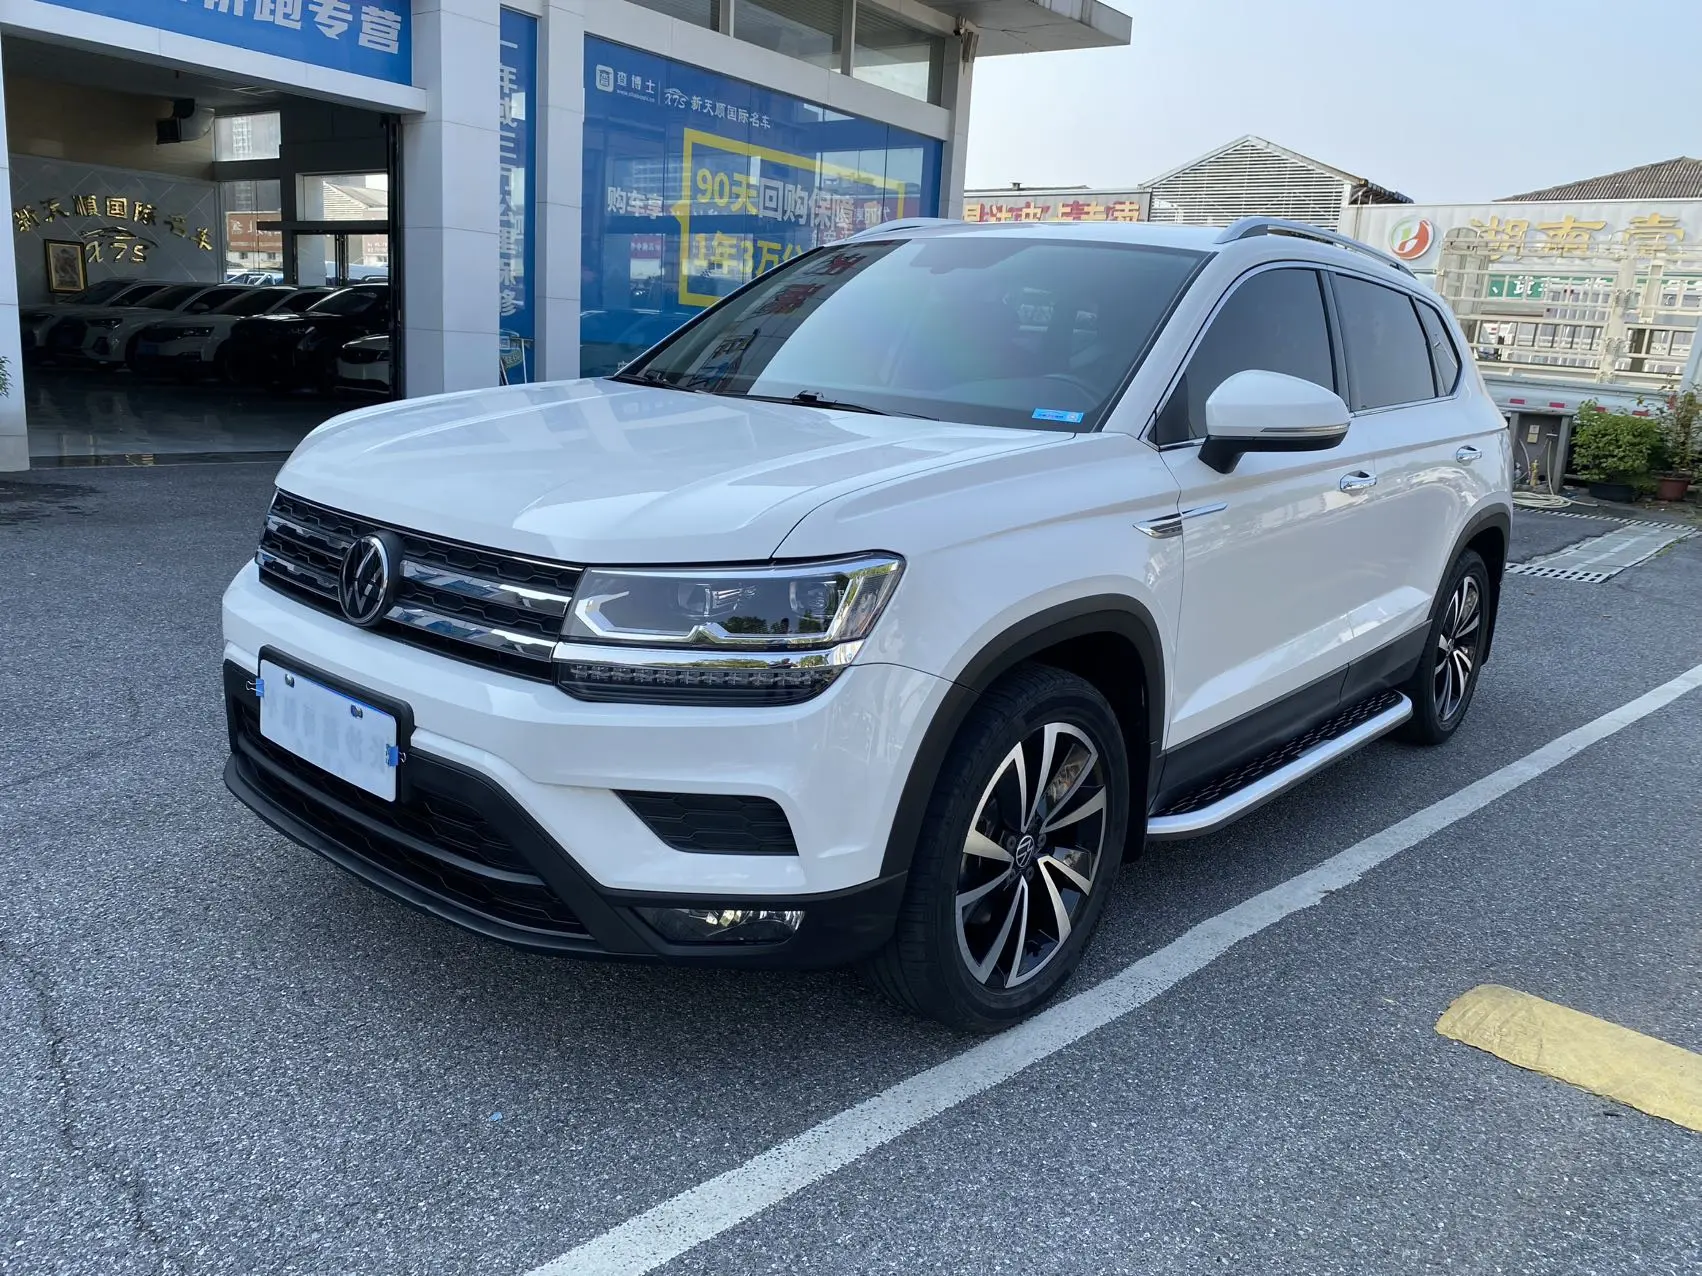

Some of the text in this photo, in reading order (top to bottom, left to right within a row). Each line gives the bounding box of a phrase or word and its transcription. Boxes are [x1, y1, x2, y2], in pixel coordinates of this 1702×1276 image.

[617, 71, 656, 94] 查博士
[691, 95, 771, 129] 新天顺国际名车
[607, 187, 664, 219] 购车享
